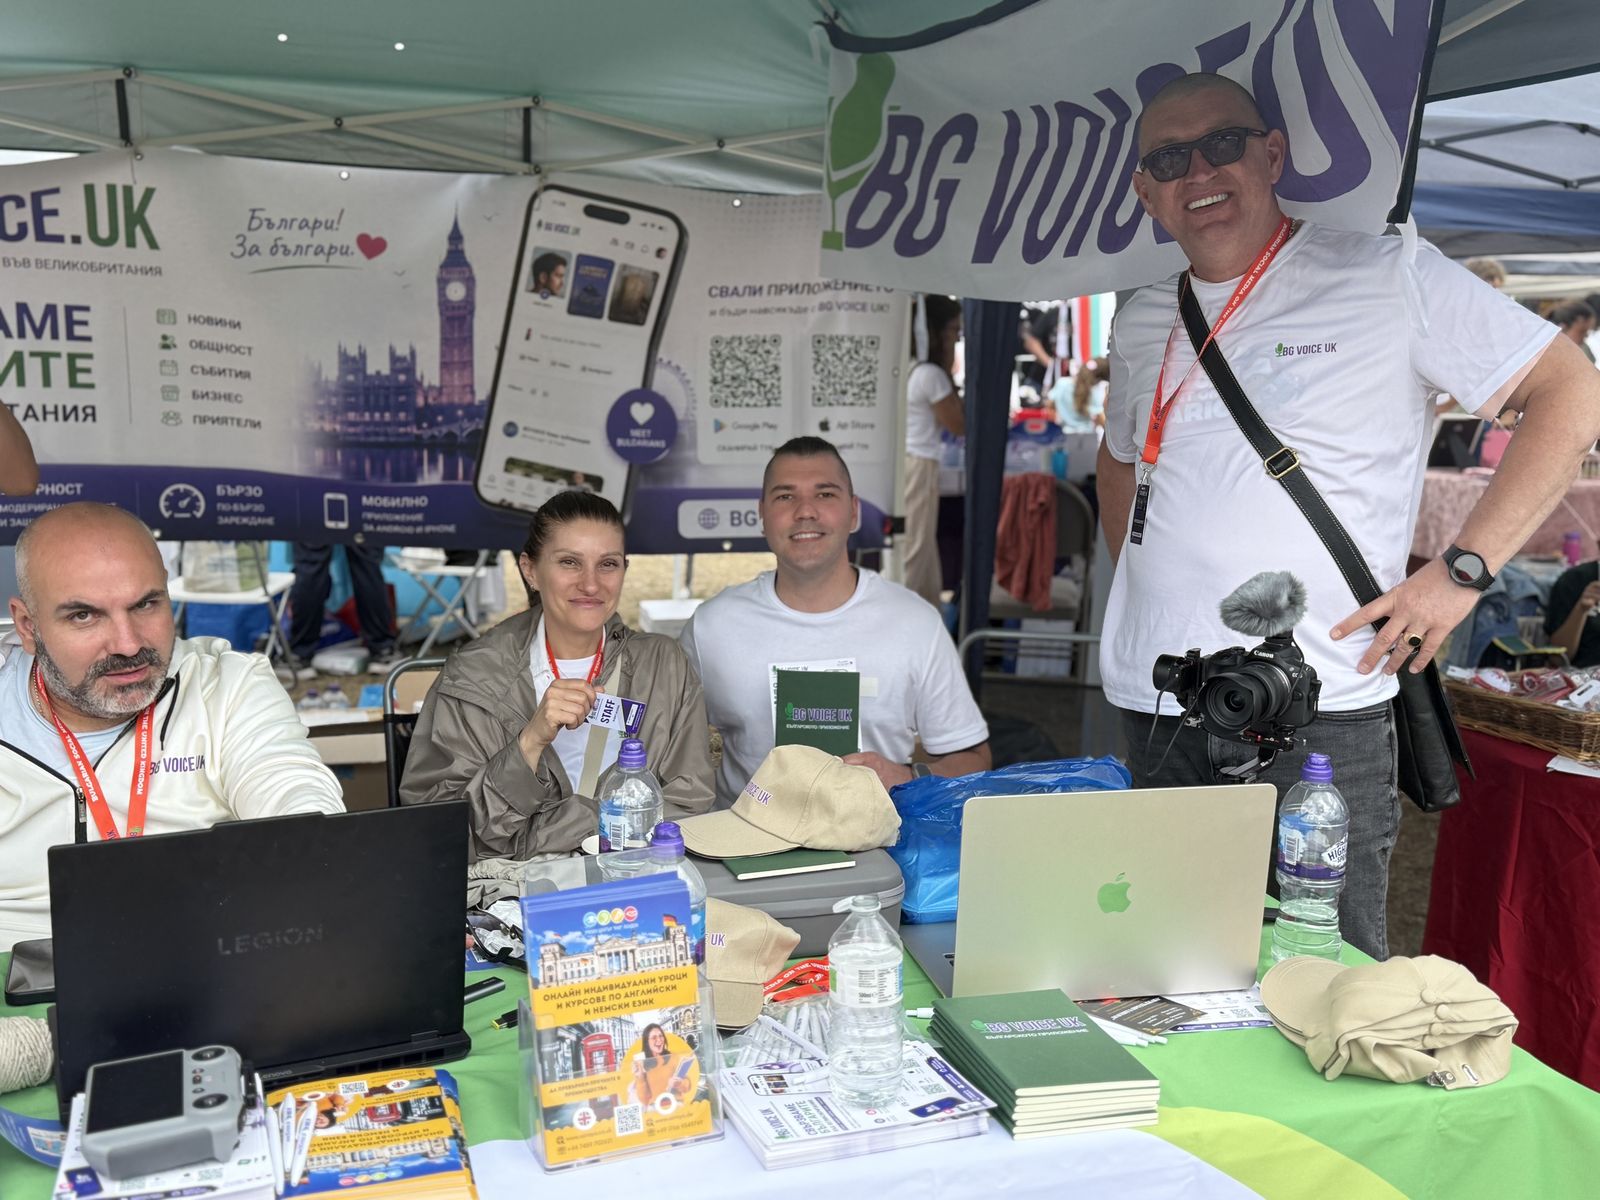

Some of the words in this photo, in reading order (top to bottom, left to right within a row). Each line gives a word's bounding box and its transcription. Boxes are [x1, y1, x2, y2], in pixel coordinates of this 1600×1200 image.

[845, 112, 979, 258] BG
[247, 208, 345, 238] Българи!
[230, 233, 262, 259] За
[269, 237, 354, 263] българи.
[2, 256, 31, 269] ВЪВ
[34, 258, 163, 277] ВЕЛИКОБРИТАНИЯ
[1252, 251, 1271, 275] SOCIAL
[708, 285, 763, 299] СВАЛИ
[1239, 274, 1255, 295] MEDIA
[818, 302, 833, 312] BG
[836, 302, 867, 313] VOICE
[188, 314, 242, 331] НОВИНИ
[189, 339, 253, 356] ОБЩНОСТ
[1283, 346, 1294, 356] BG
[1297, 344, 1322, 355] VOICE
[1324, 342, 1337, 352] UK
[190, 365, 251, 380] СЪБИТИЯ
[192, 389, 243, 404] БИЗНЕС
[193, 414, 262, 430] ПРИЯТЕЛИ
[732, 421, 760, 431] Google
[762, 420, 778, 431] Play
[851, 420, 875, 430] Store
[630, 428, 651, 438] MEET
[616, 437, 666, 449] BULGARIANS
[216, 484, 263, 497] БЪРЗО
[362, 495, 428, 508] МОБИЛНО
[1253, 650, 1274, 659] Canon
[600, 699, 615, 724] STAFF
[793, 707, 806, 721] BG
[808, 708, 837, 721] VOICE
[838, 708, 853, 722] UK
[65, 734, 81, 760] SOCIAL
[140, 731, 148, 759] UNITED
[163, 756, 195, 773] VOICE
[76, 760, 99, 803] BULGARIAN
[136, 760, 146, 796] KINGDOM
[757, 789, 772, 805] UK
[218, 926, 322, 955] LEGION
[711, 933, 726, 947] UK
[783, 969, 795, 978] ON
[795, 962, 810, 971] THE
[543, 987, 581, 1002] ОНЛАЙН
[584, 977, 656, 995] ИНДИВИДУАЛНИ
[658, 971, 688, 985] УРОЦИ
[556, 1001, 563, 1010] И
[565, 995, 606, 1009] КУРСОВЕ
[609, 993, 622, 1002] ПО
[623, 984, 677, 1001] АНГЛИЙСКИ
[584, 1008, 591, 1016] И
[593, 1003, 630, 1014] НЕМСКИ
[632, 998, 655, 1008] ЕЗИК
[985, 1021, 1011, 1033] BG
[1008, 1019, 1060, 1032] VOICE
[1056, 1016, 1086, 1028] UK
